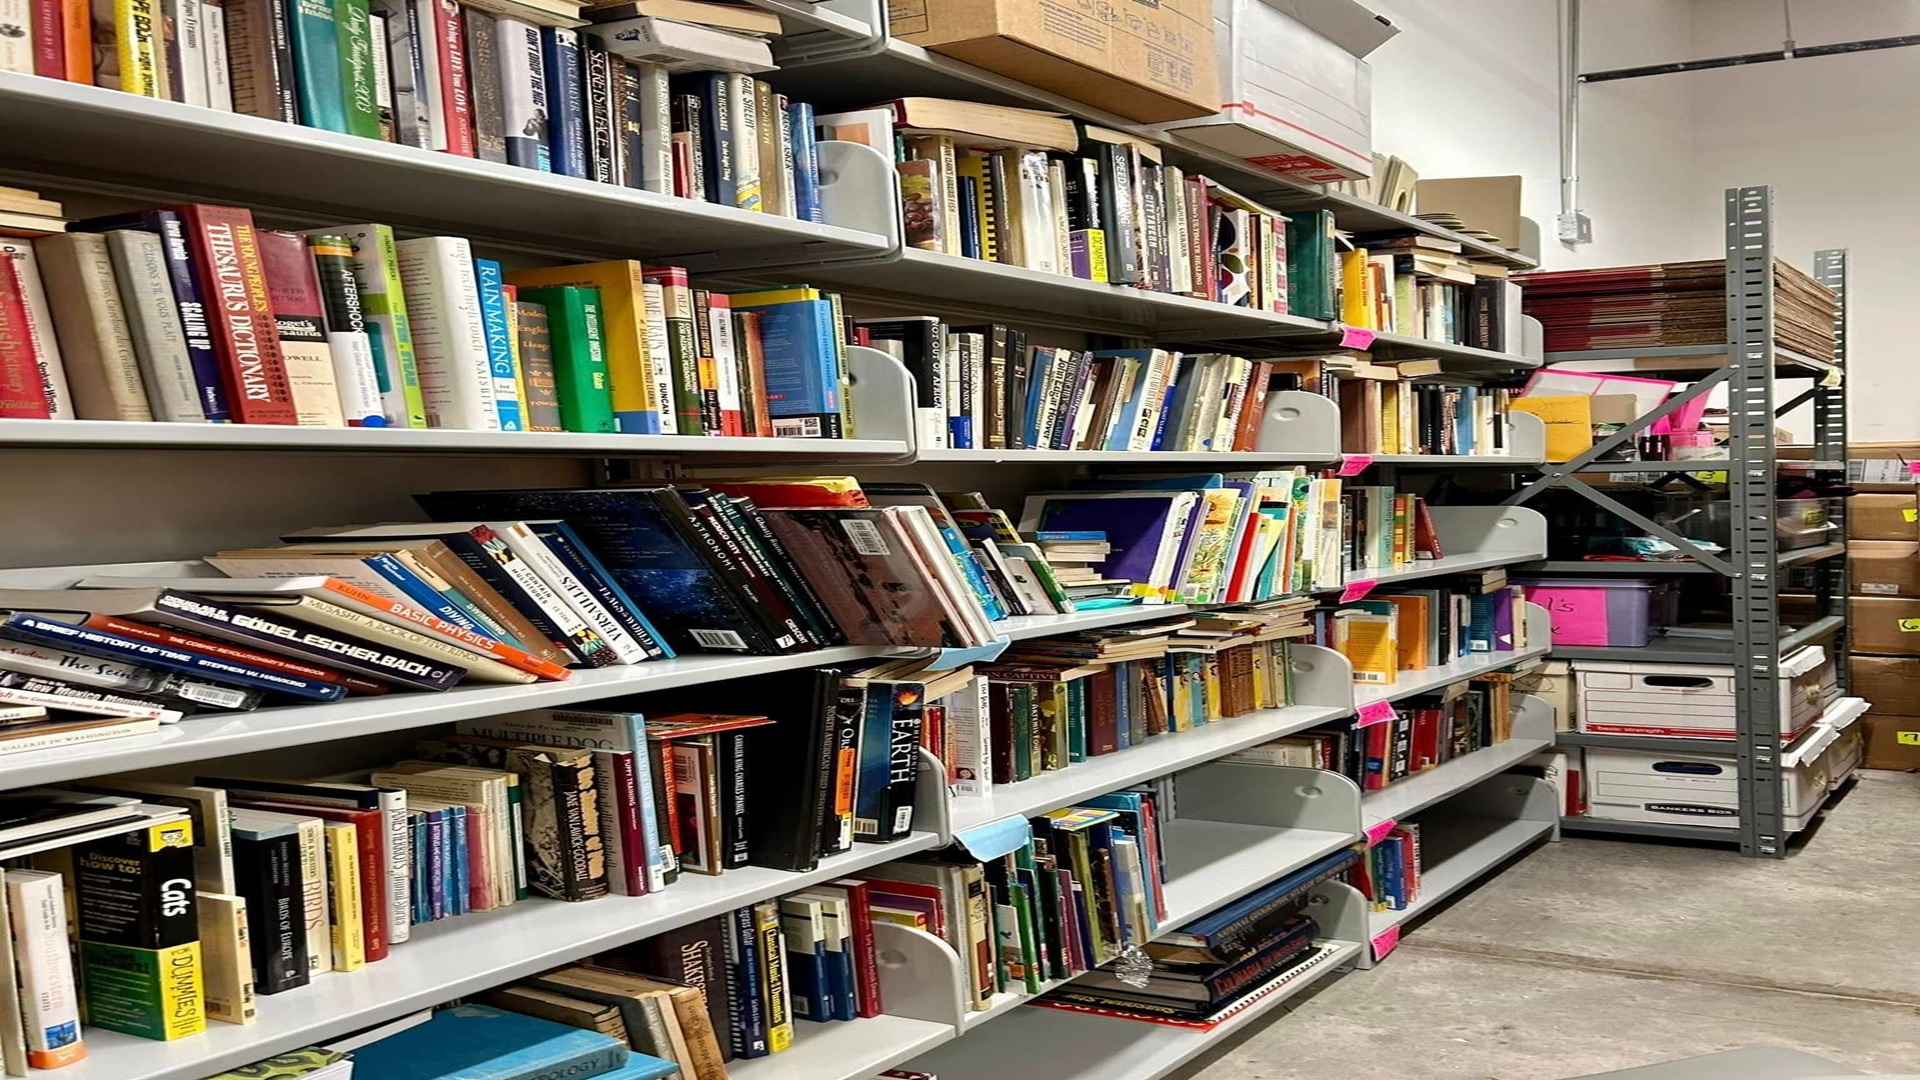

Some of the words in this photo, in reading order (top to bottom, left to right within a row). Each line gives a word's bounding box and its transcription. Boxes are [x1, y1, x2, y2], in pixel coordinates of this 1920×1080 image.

[342, 3, 368, 35] Daily
[446, 20, 460, 43] Living
[525, 28, 540, 54] DON'T
[346, 36, 369, 83] Guideposts
[449, 50, 464, 74] LIFE
[528, 52, 542, 76] DROP
[564, 50, 579, 80] JOYCE
[453, 73, 463, 88] You
[530, 74, 544, 91] THE
[588, 49, 608, 104] SECRETS
[716, 80, 729, 98] MIKE
[740, 77, 755, 97] GAIL
[354, 82, 372, 114] 2003
[454, 88, 468, 115] LOVE
[532, 89, 546, 107] MIC
[568, 80, 581, 113] MEYER
[656, 79, 671, 115] DARING
[718, 96, 730, 132] HUCKABEE
[742, 97, 757, 131] SHEEHY
[593, 114, 611, 147] FACE
[660, 124, 672, 149] REST
[780, 112, 792, 147] MASTER
[662, 153, 673, 178] KAREN
[784, 147, 794, 171] ASKER
[1114, 155, 1127, 184] SPEED
[947, 198, 958, 214] FISH
[1145, 193, 1156, 213] CITY
[235, 224, 251, 244] THE
[1146, 213, 1158, 248] TAVERN
[1192, 218, 1204, 254] ULTIMATE
[206, 223, 249, 312] THESAURUS
[241, 242, 261, 275] YOUNG
[1194, 254, 1206, 286] HEALING
[247, 272, 269, 312] PEOPLE'S
[340, 269, 367, 334] AFTERSHOCK
[642, 289, 661, 317] TIME
[179, 301, 208, 337] SCALING
[481, 306, 500, 347] RAIN
[931, 319, 941, 340] NOT
[189, 338, 211, 350] UP
[646, 318, 666, 350] TRAPS
[227, 314, 271, 404] DICTIONARY
[931, 341, 941, 362] OUT
[932, 362, 942, 374] OF
[961, 350, 971, 382] KENNEDY
[1054, 357, 1068, 380] John
[475, 359, 495, 415] NAISBITT
[485, 348, 511, 415] MAKING
[932, 376, 943, 410] AFRICA
[1048, 379, 1064, 407] Edgar
[659, 383, 671, 416] DUNCAN
[962, 389, 971, 411] NIXON
[1042, 407, 1058, 441] Hoover
[687, 514, 737, 571] ASTRONOMY
[707, 515, 730, 541] MEXICO
[726, 540, 741, 554] CITY
[755, 516, 773, 538] Ghostly
[769, 538, 785, 556] Ruins
[336, 583, 371, 602] KUHN
[511, 567, 549, 606] MULTITUDES
[524, 572, 553, 599] CONTAIN
[438, 605, 475, 631] DIVING
[465, 602, 506, 636] SWIMMING
[559, 575, 623, 642] VERSAILLES
[598, 586, 625, 614] FLAGS
[624, 615, 654, 646] WORLD
[304, 599, 361, 624] MUSASHI
[375, 623, 408, 640] BOOK
[407, 632, 425, 643] OF
[423, 636, 449, 652] FIVE
[448, 646, 480, 662] RINGS
[389, 603, 434, 627] BASIC
[435, 618, 497, 651] PHYSICS
[784, 618, 809, 644] CRESCENT
[33, 621, 78, 638] BRIEF
[77, 631, 140, 651] HISTORY
[138, 644, 160, 655] OF
[157, 648, 193, 662] TIME
[59, 654, 93, 671] The
[95, 663, 142, 682] Seine
[197, 659, 246, 675] STEPHEN
[258, 673, 308, 688] HAWKING
[381, 654, 433, 678] BACH
[1003, 671, 1059, 681] CAPTIVE
[22, 680, 53, 694] New
[53, 685, 101, 701] Mexico
[824, 704, 837, 732] NORTH
[470, 727, 566, 747] MULTIPLE
[566, 736, 613, 751] DOG
[734, 734, 744, 759] CAVALIER
[821, 732, 834, 770] AMERICAN
[890, 717, 914, 784] EARTH
[624, 758, 634, 777] PUPPY
[734, 759, 744, 772] KING
[909, 725, 920, 782] SMITHSONIAN
[663, 759, 675, 784] Forest
[734, 772, 745, 795] CHARLES
[819, 770, 830, 790] BIRD
[563, 790, 581, 808] JANE
[626, 777, 637, 807] TRAINING
[664, 785, 677, 816] Unseen
[735, 794, 745, 816] SPANIEL
[388, 806, 408, 832] JAMES
[567, 807, 582, 823] VAN
[1649, 803, 1701, 814] BANKERS
[1706, 806, 1733, 816] BOX
[391, 831, 409, 871] HERRIOT'S
[80, 857, 113, 872] how
[118, 862, 141, 875] to:
[160, 878, 194, 918] Cats
[277, 897, 291, 921] BIRDS
[302, 879, 326, 931] BIRDS
[280, 920, 292, 932] OF
[740, 928, 755, 947] Guitar
[864, 933, 875, 946] Early
[280, 931, 293, 961] EUROPE
[764, 929, 781, 961] Classical
[866, 945, 876, 966] Modern
[768, 960, 782, 982] Music
[867, 965, 878, 983] English
[170, 953, 197, 1019] DUMMIES
[869, 982, 879, 999] Drama
[770, 987, 784, 1024] Dummies
